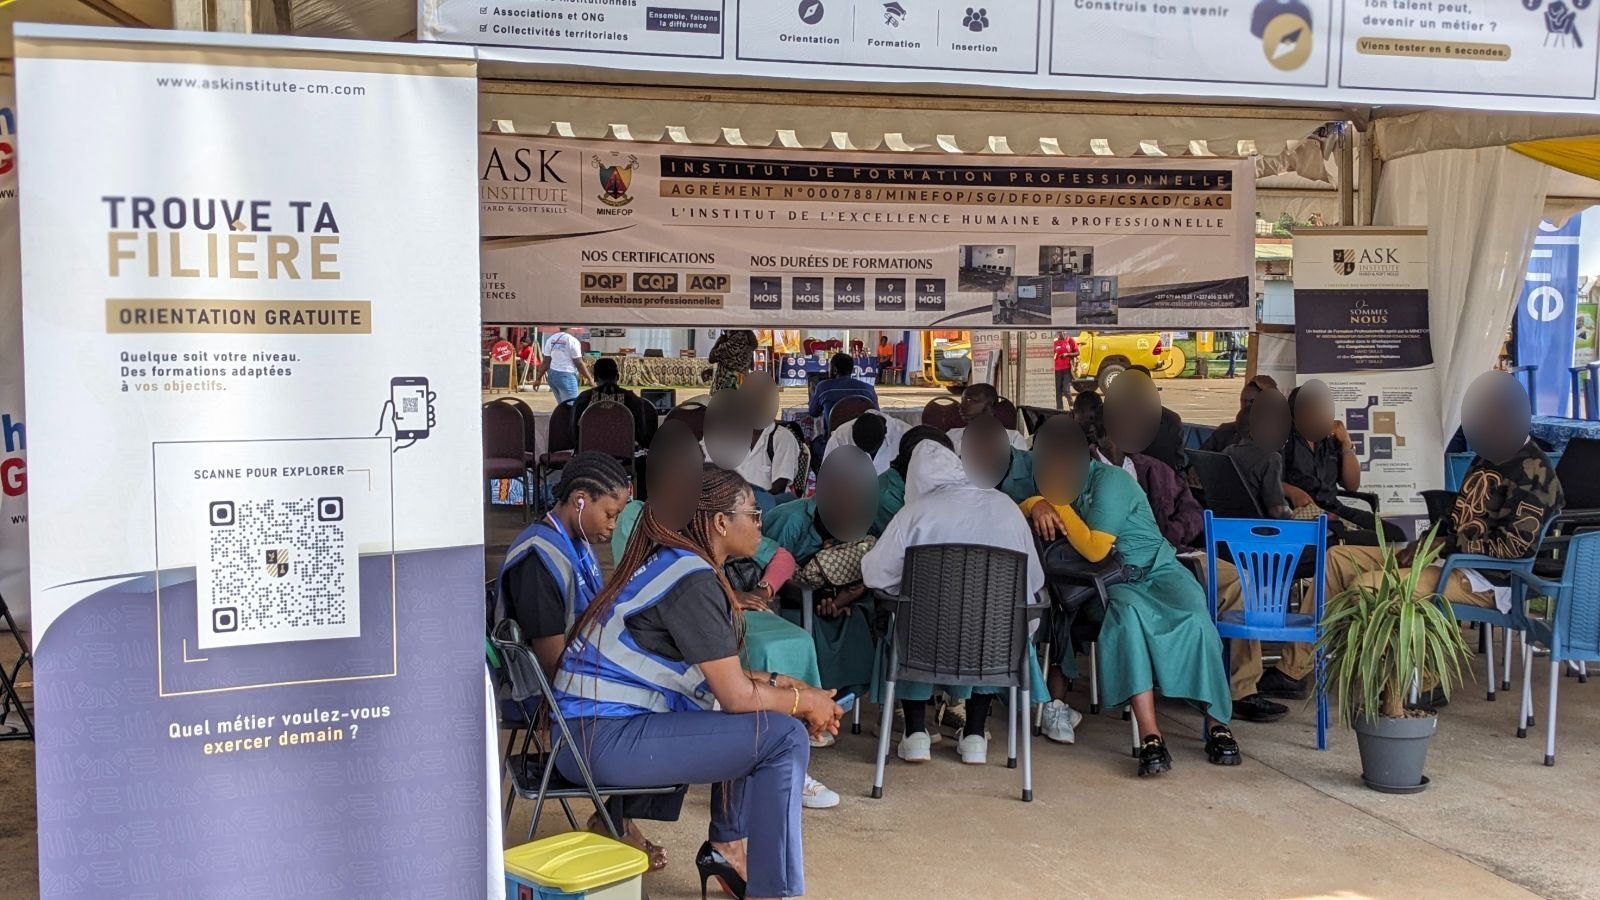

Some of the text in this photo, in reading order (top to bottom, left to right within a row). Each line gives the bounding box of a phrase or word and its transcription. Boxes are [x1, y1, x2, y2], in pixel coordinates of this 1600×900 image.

[1074, 0, 1229, 17] Construis ton avenir
[1393, 0, 1433, 11] talent
[1438, 3, 1472, 14] peut,
[493, 7, 605, 22] Associations et ONG
[648, 11, 718, 22] Ensemble, faisons
[669, 21, 707, 30] différence
[1362, 15, 1497, 32] devenir un métier ?
[493, 25, 628, 41] Collectivités territoriales
[779, 34, 840, 45] Orientation
[867, 38, 921, 49] Formation
[952, 43, 998, 52] Insertion
[1361, 41, 1390, 51] Viens
[1394, 43, 1426, 53] tester
[1455, 46, 1507, 57] secondes.
[156, 77, 366, 96] www.askinstitute-cm.com
[482, 147, 567, 184] ASK
[671, 161, 1224, 187] INSTITUT DE FORMATION PROFESSIONNELLE
[481, 186, 568, 202] INSTITUTE
[672, 182, 774, 198] AGRÉMENT
[101, 196, 340, 234] TROUVE TA
[542, 206, 568, 214] SKILLS
[596, 208, 633, 216] MINEFOP
[672, 208, 1224, 228] L'INSTITUT DE L'EXCELLENCE HUMAINE & PROFESSIONNELLE
[108, 219, 341, 280] FILIÈRE
[1358, 248, 1400, 264] ASK
[581, 250, 715, 264] NOS CERTIFICATIONS
[750, 254, 933, 270] NOS DURÉES DE FORMATIONS
[584, 274, 624, 290] DQP
[638, 274, 675, 290] CQP
[690, 276, 728, 290] AQP
[763, 282, 768, 291] 1
[804, 282, 811, 292] 3
[846, 282, 852, 292] 6
[887, 283, 894, 292] 9
[926, 284, 935, 293] 12
[584, 294, 721, 306] Attestations professionnelles
[754, 294, 778, 303] MOIS
[796, 294, 820, 303] MOIS
[837, 295, 861, 304] MOIS
[878, 296, 902, 304] MOIS
[918, 296, 942, 304] MOIS
[119, 308, 362, 326] ORIENTATION GRATUITE
[1350, 316, 1388, 324] NOUS
[120, 351, 301, 364] Quelque soit votre niveau.
[121, 365, 292, 378] Des formations adaptées
[121, 380, 226, 394] à vos objectifs.
[194, 464, 344, 480] SCANNE POUR EXPLORER
[169, 706, 391, 738] Quel métier voulez-vous
[204, 724, 359, 755] exercer demain ?
